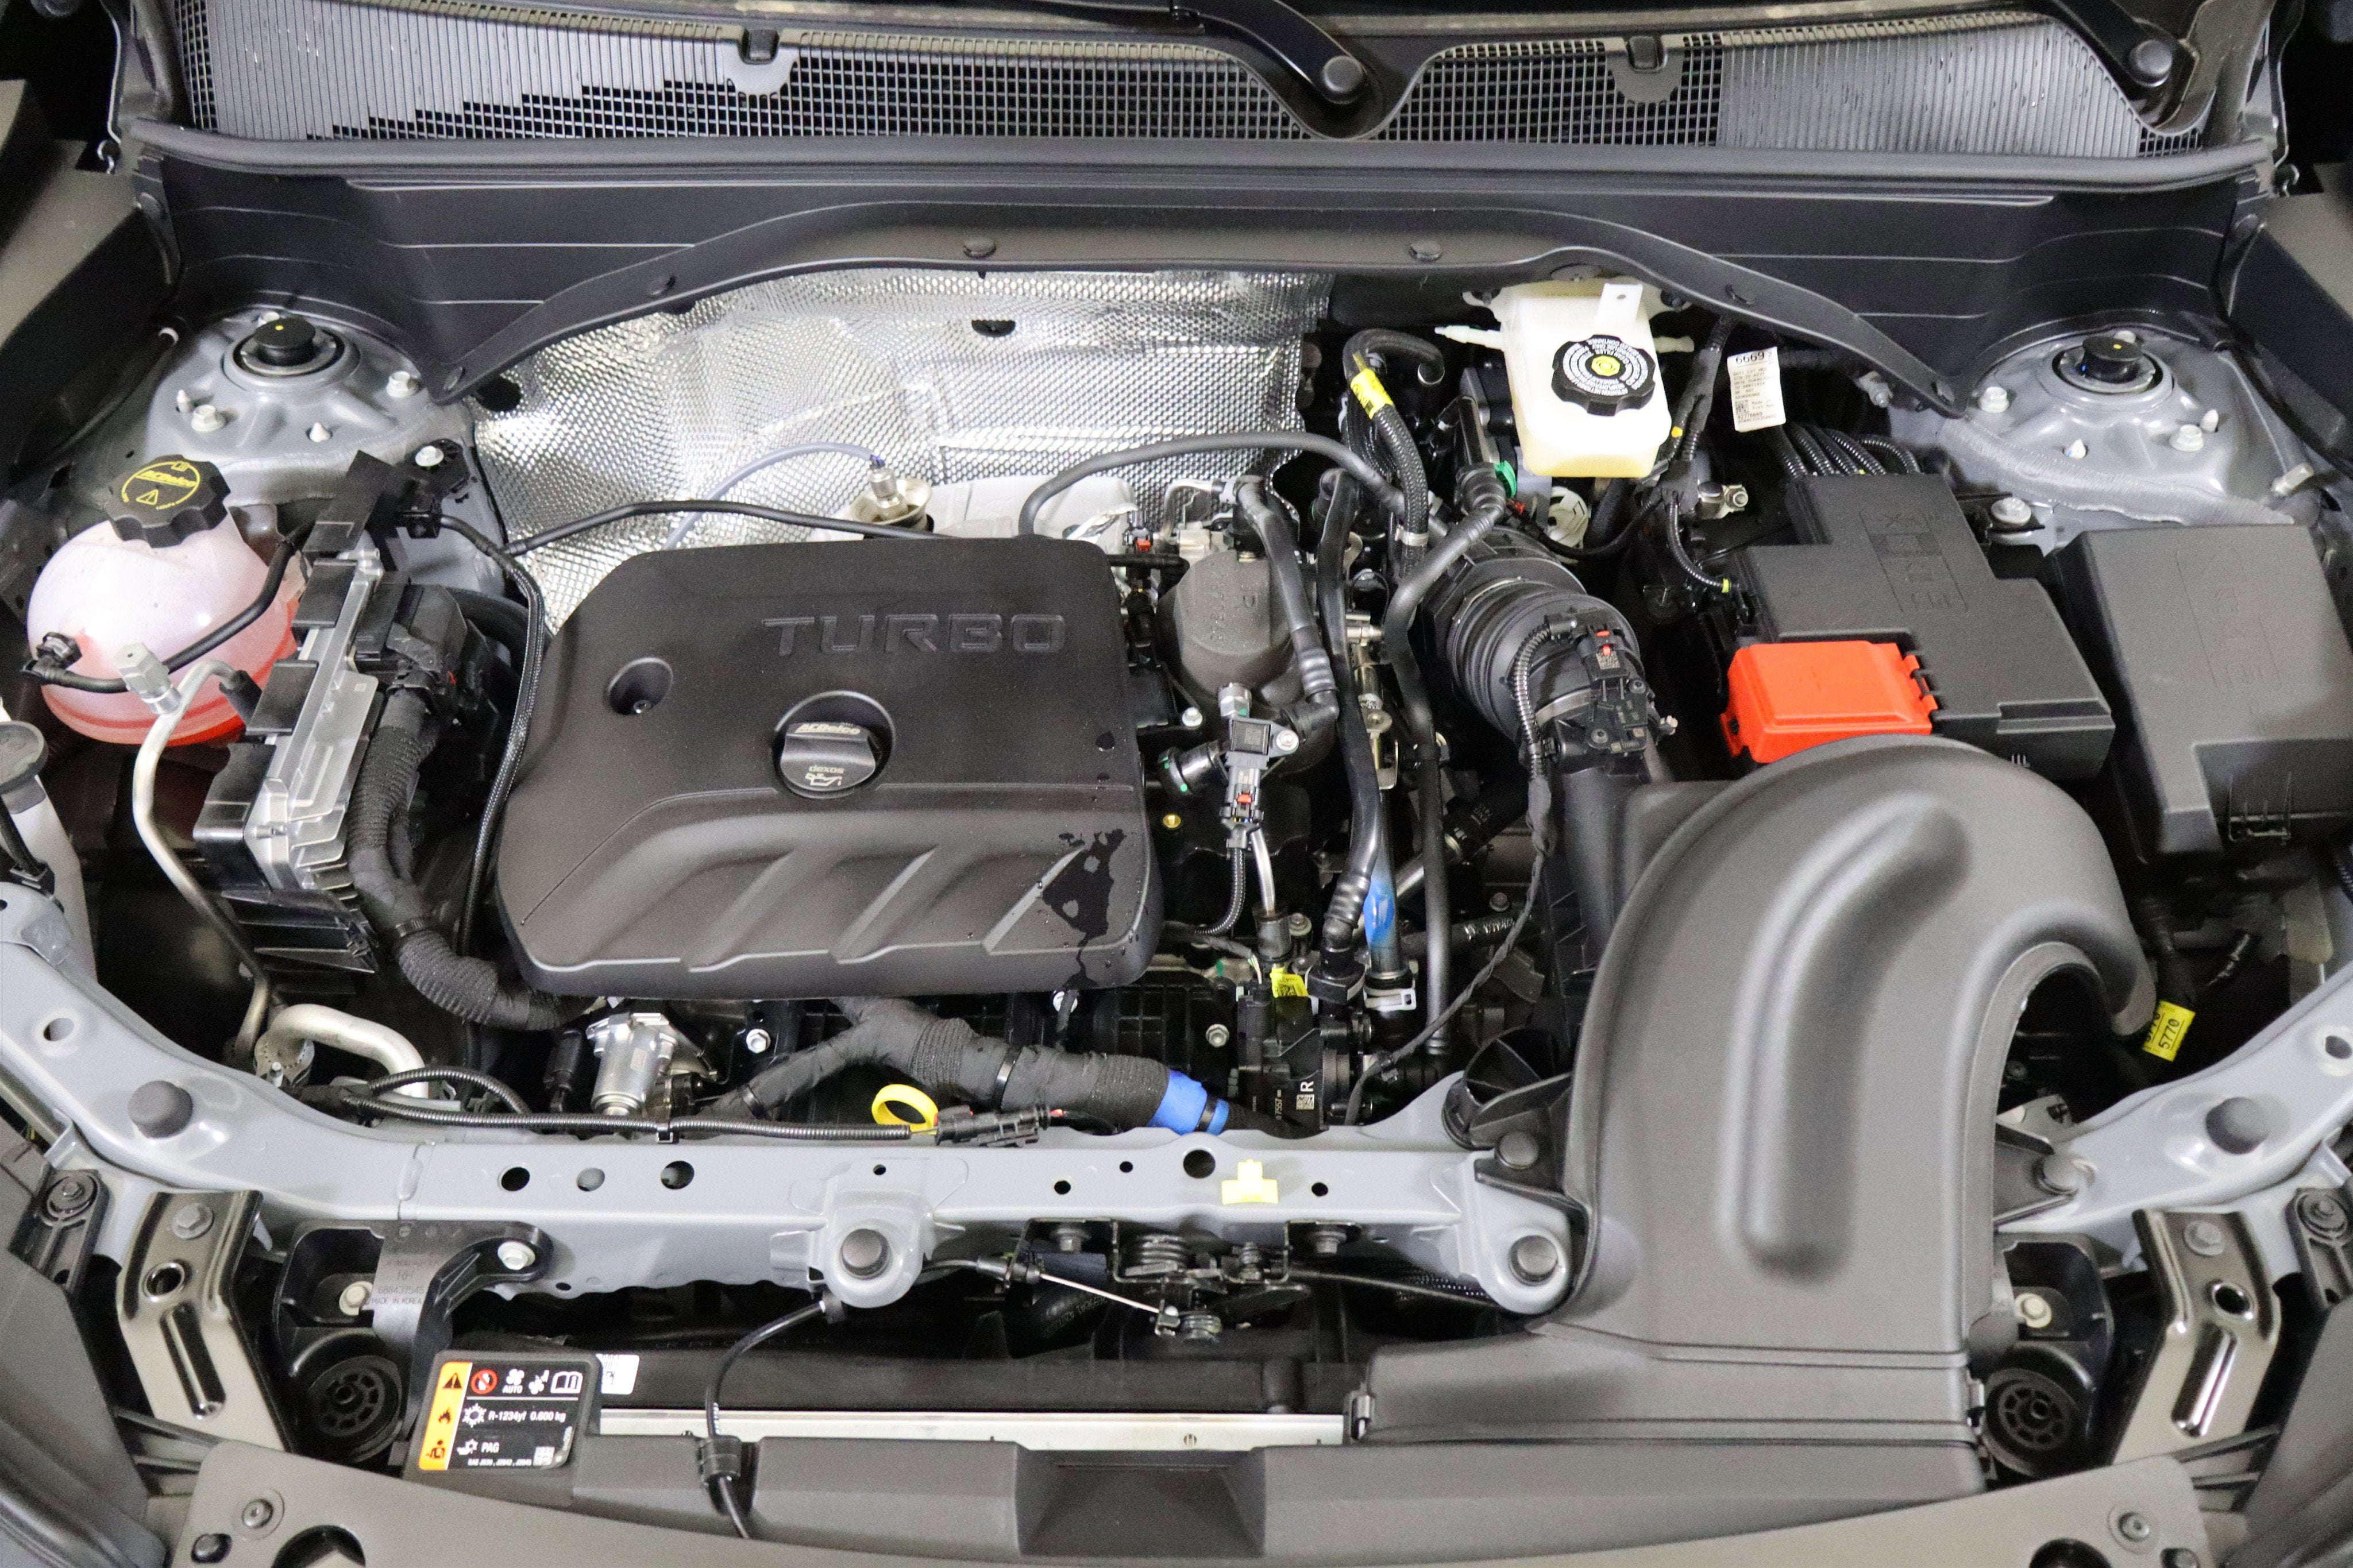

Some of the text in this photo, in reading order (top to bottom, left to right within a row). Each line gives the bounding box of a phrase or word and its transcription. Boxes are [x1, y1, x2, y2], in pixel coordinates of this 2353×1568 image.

[1736, 351, 1765, 365] 6669
[762, 613, 1066, 656] TURBO
[794, 723, 861, 735] ACDelco
[809, 765, 845, 774] dexos
[2158, 1018, 2180, 1049] 5770
[1300, 1081, 1314, 1092] R
[502, 1385, 523, 1394] AUTO
[488, 1411, 566, 1423] R-1234yf 0.600 kg
[481, 1442, 500, 1453] PAG
